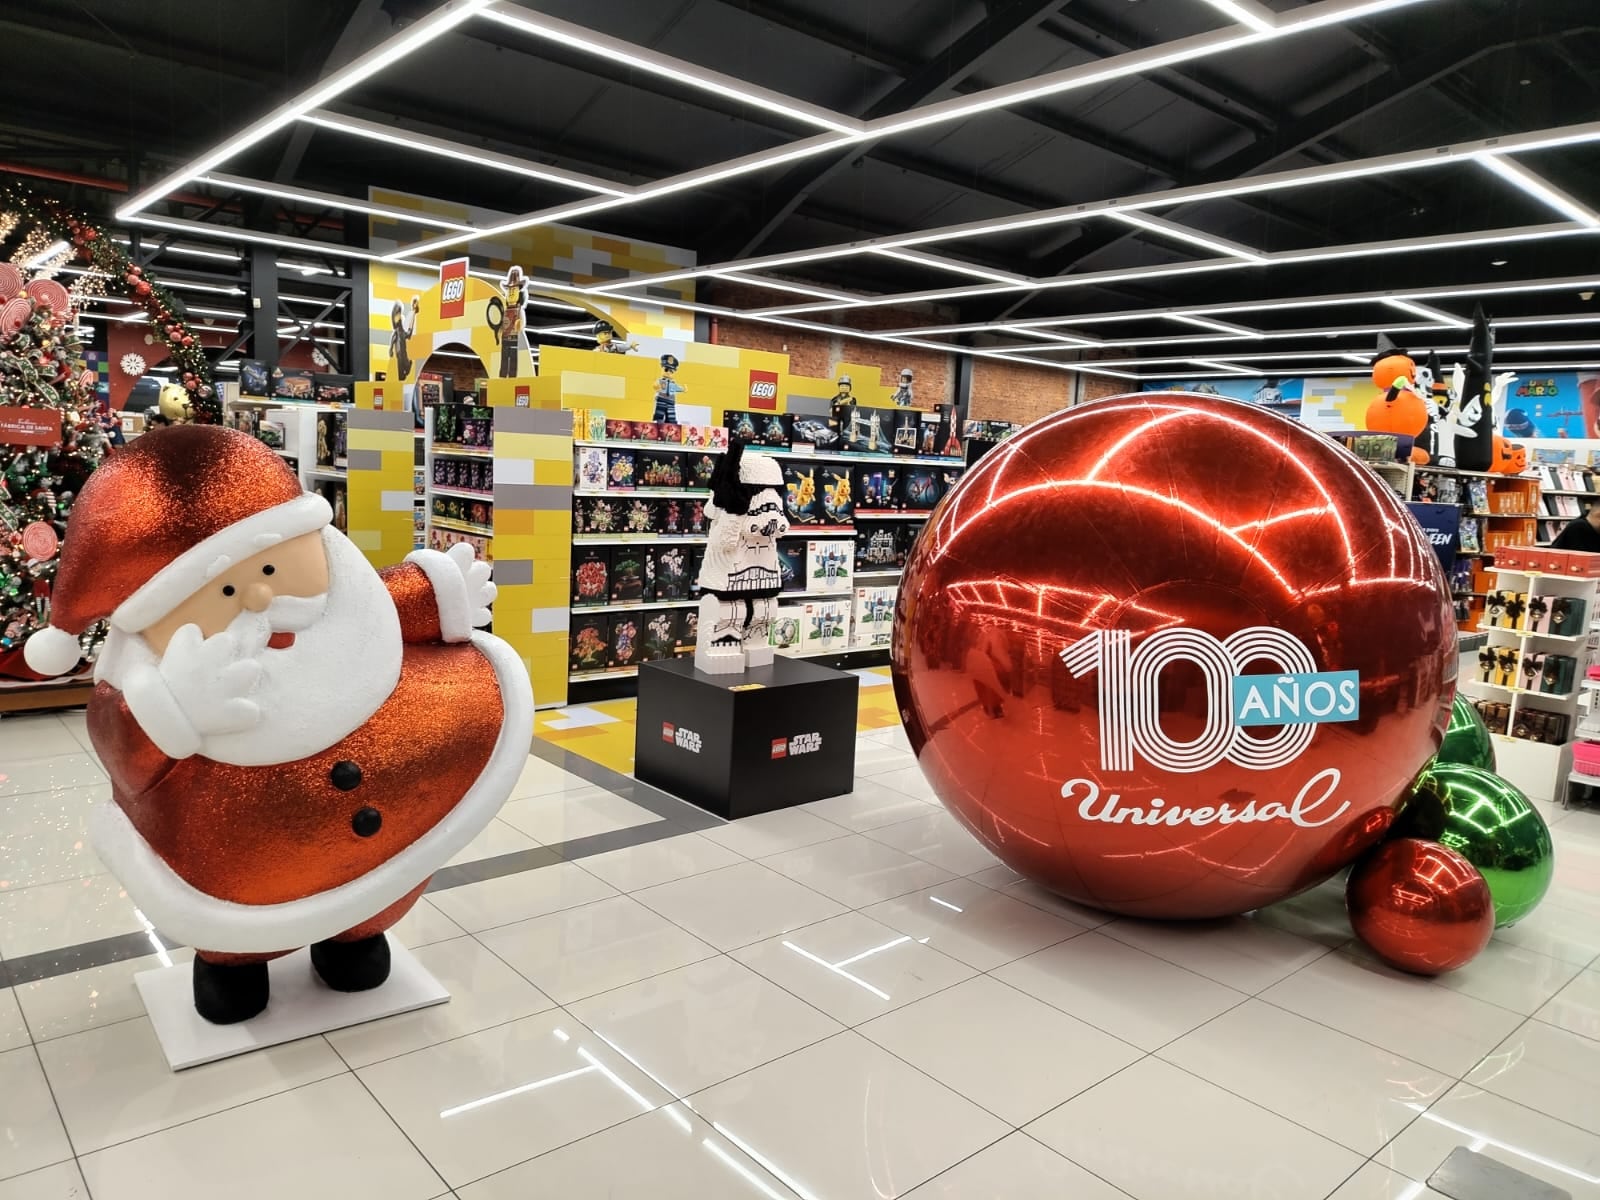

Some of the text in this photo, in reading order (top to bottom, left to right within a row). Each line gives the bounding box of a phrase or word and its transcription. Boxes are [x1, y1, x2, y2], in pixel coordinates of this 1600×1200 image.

[442, 278, 464, 302] LEGO
[751, 382, 776, 398] LEGO
[827, 567, 836, 578] 10
[1059, 626, 1317, 773] 100
[1238, 676, 1356, 719] AÑOS
[675, 727, 702, 745] STAR
[676, 735, 702, 754] WARS
[790, 732, 822, 746] STAR
[789, 742, 821, 756] WARS
[1060, 768, 1351, 828] Universal
